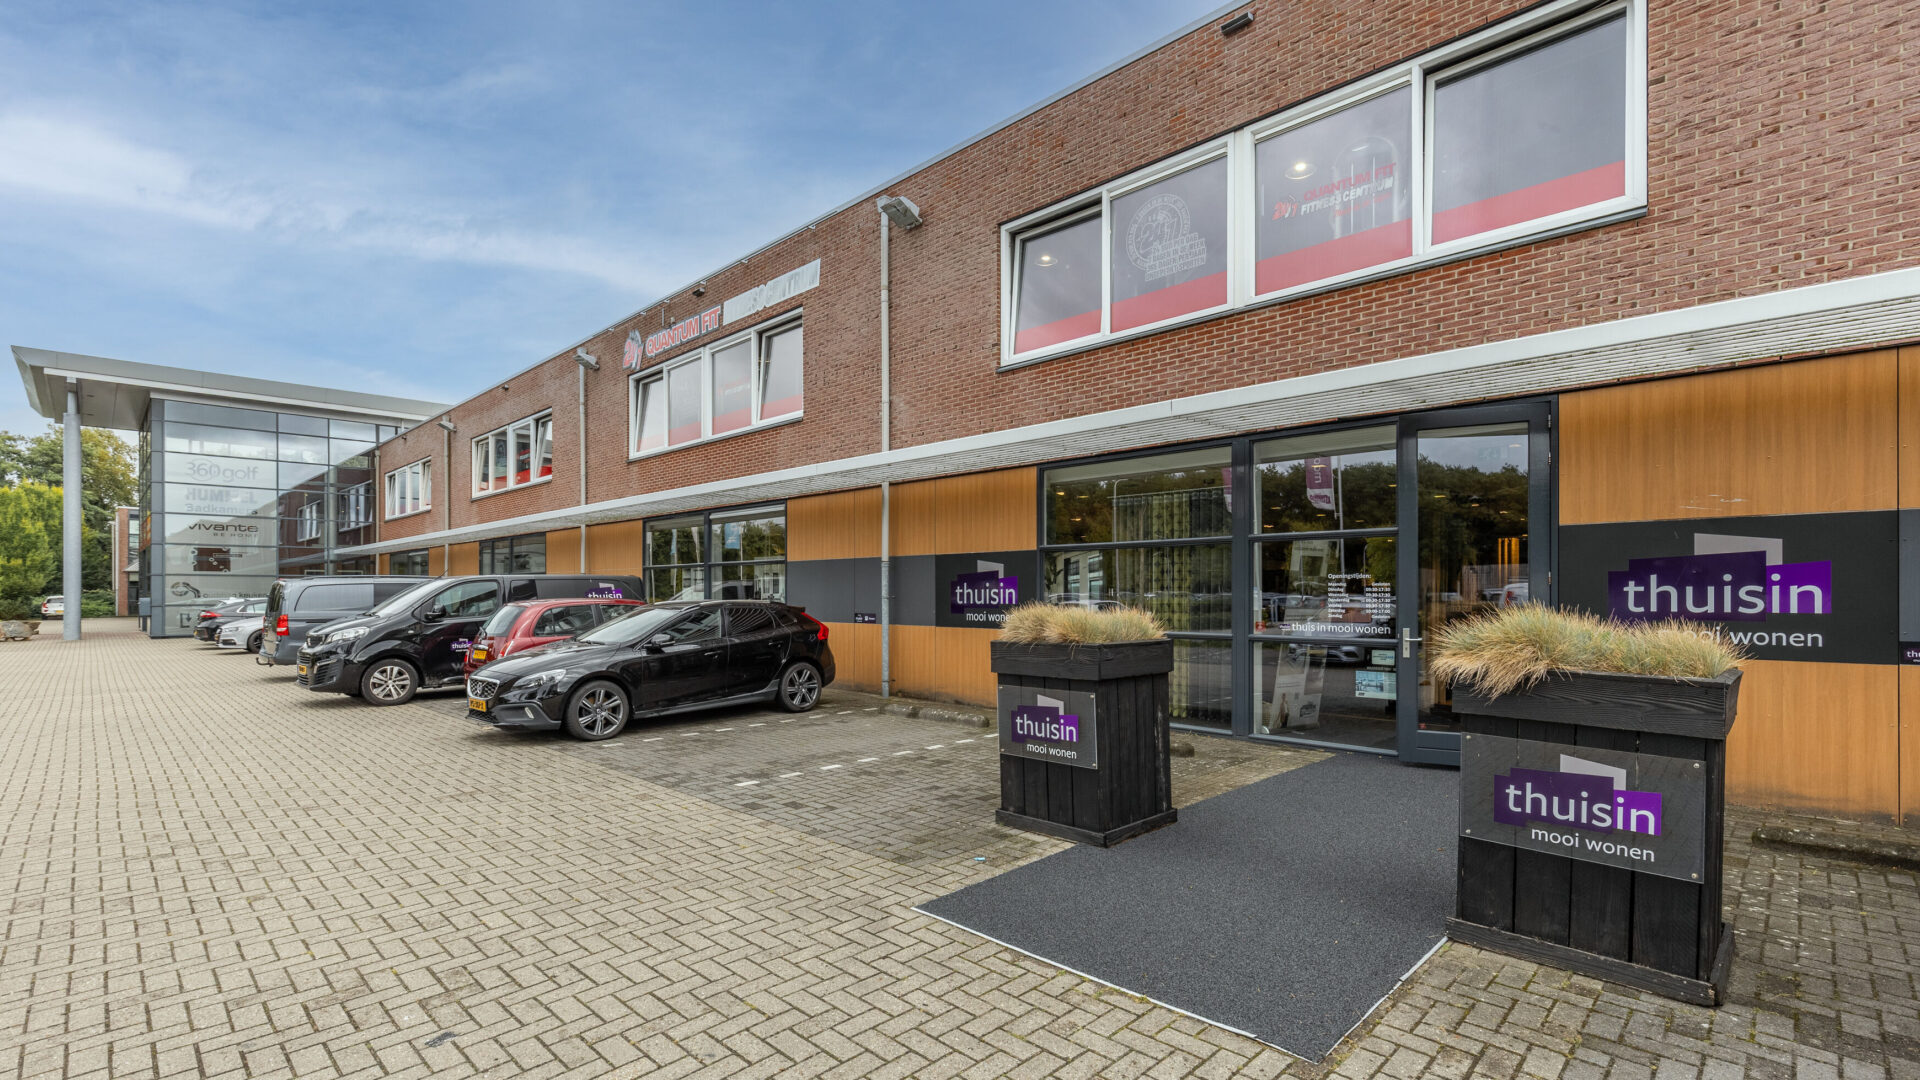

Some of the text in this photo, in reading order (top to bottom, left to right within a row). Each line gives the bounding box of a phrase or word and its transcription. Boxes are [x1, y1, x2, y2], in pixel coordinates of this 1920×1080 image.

[1303, 162, 1397, 201] QUANTUM FIT
[1301, 190, 1342, 216] FITNESS
[646, 304, 722, 357] QUANTUM FIT
[588, 591, 623, 599] thuisin
[955, 582, 1016, 605] thuisin
[1623, 573, 1823, 614] thuisin
[966, 611, 1013, 622] mooi wone
[1292, 622, 1315, 632] thuis
[1317, 622, 1326, 632] in
[1328, 623, 1354, 633] mooi
[1356, 625, 1391, 634] wonen
[1730, 629, 1823, 648] wonen
[1015, 713, 1077, 743] thuisin
[1026, 743, 1077, 759] mooi wonen
[1505, 781, 1656, 836] thuisin
[1531, 828, 1656, 863] mooi wonen
